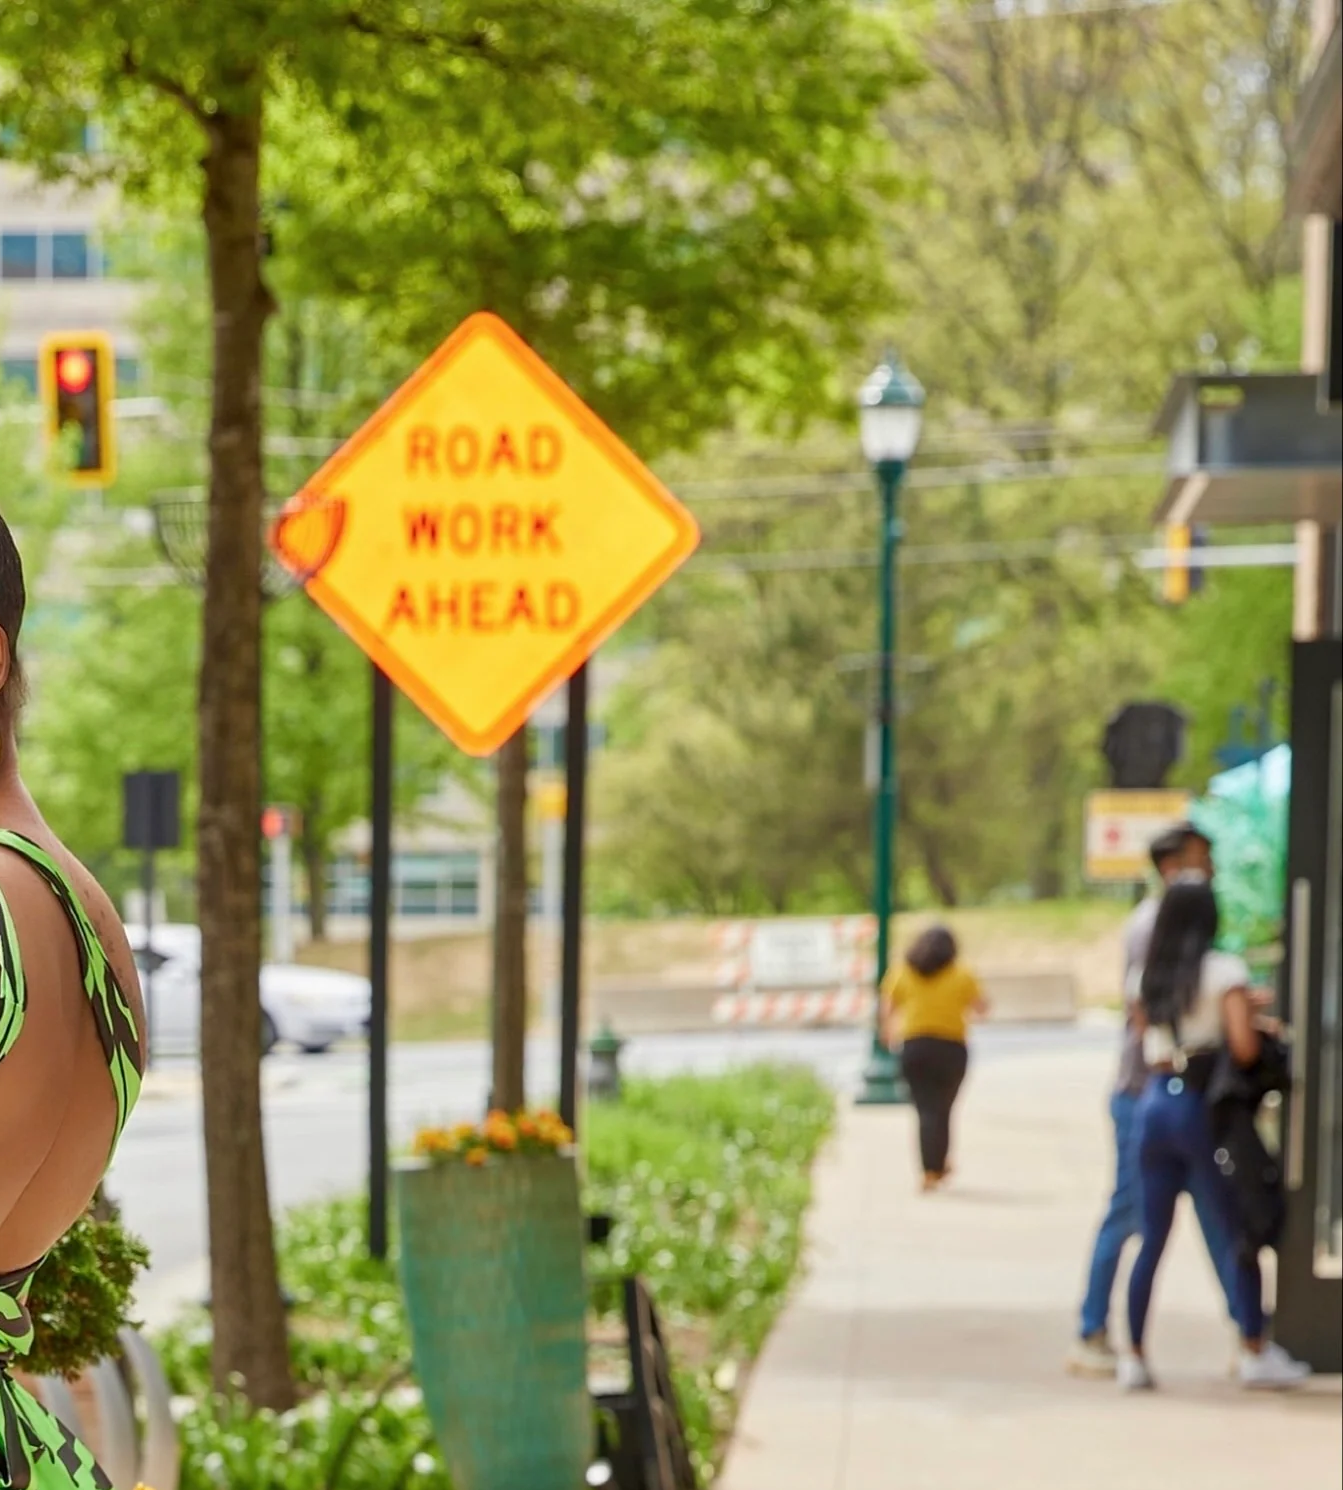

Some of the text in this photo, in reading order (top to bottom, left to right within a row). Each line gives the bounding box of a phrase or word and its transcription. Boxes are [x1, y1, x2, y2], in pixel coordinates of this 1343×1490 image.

[406, 424, 564, 476] ROAD
[403, 502, 563, 554] WORK
[387, 580, 581, 633] AHEAD
